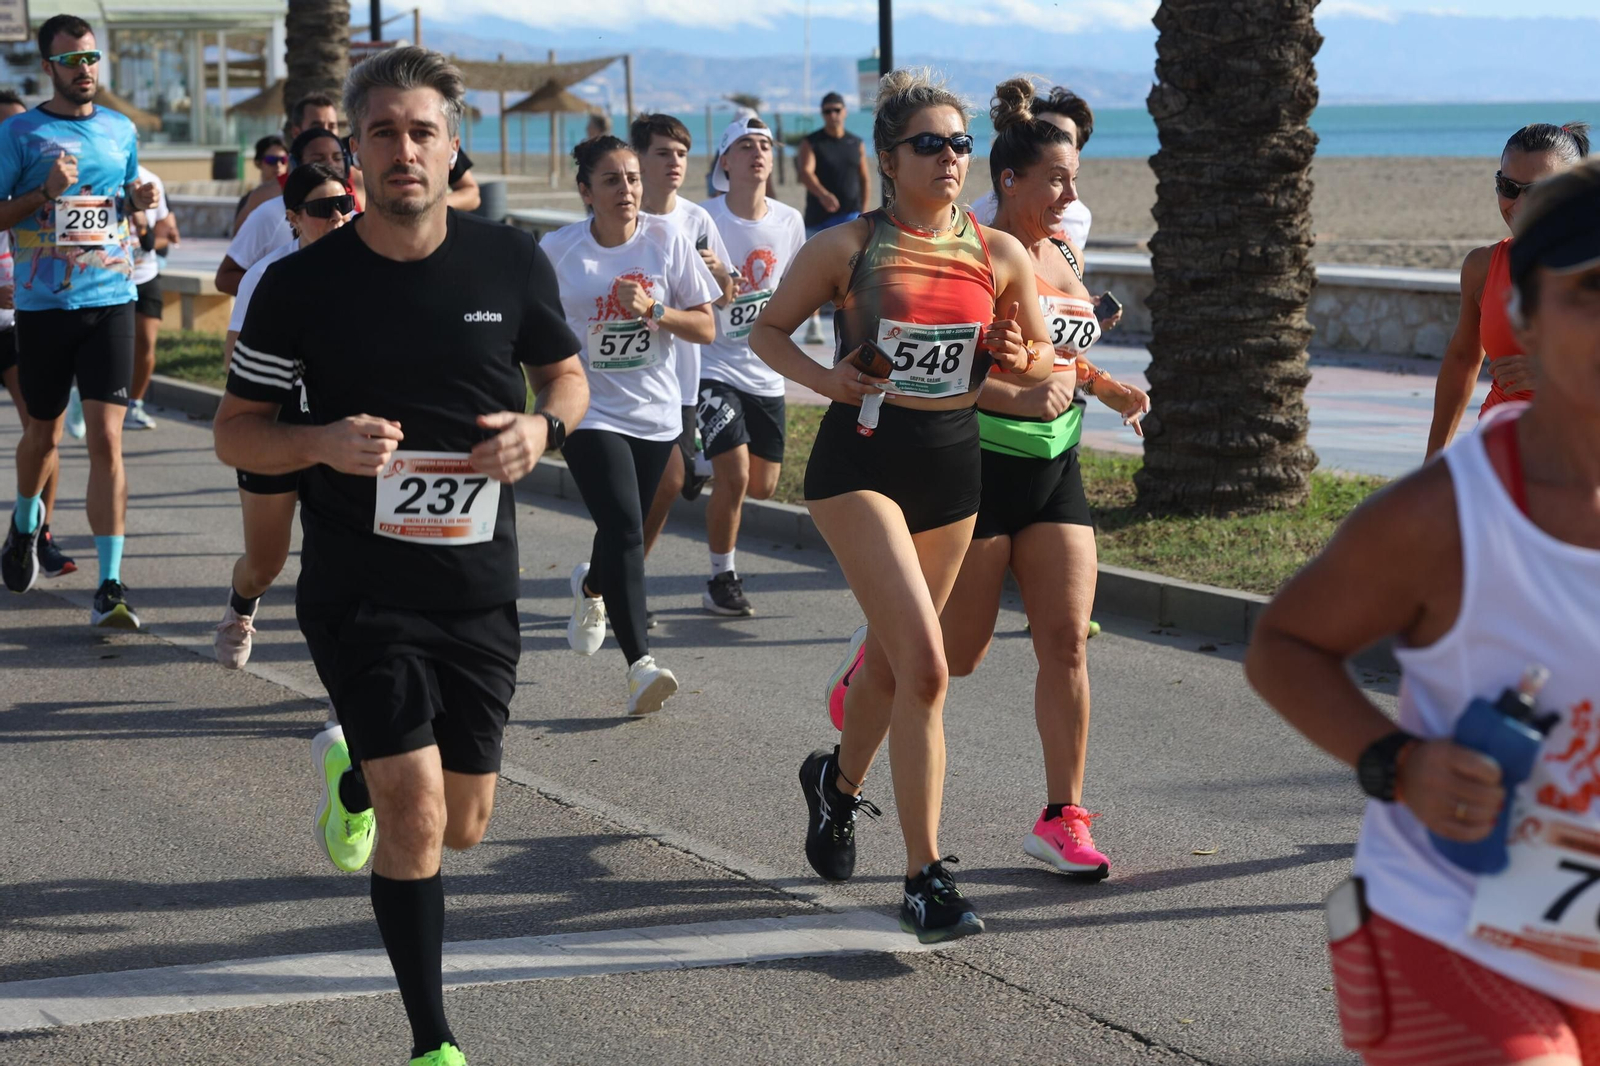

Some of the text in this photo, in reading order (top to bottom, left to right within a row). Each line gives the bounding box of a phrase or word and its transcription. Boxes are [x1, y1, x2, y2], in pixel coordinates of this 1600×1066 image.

[65, 209, 108, 229] 289
[464, 310, 502, 322] adidas
[600, 330, 650, 356] 573
[1052, 318, 1095, 348] 378
[893, 342, 964, 375] 548
[394, 477, 488, 515] 237
[1543, 860, 1600, 930] 7
